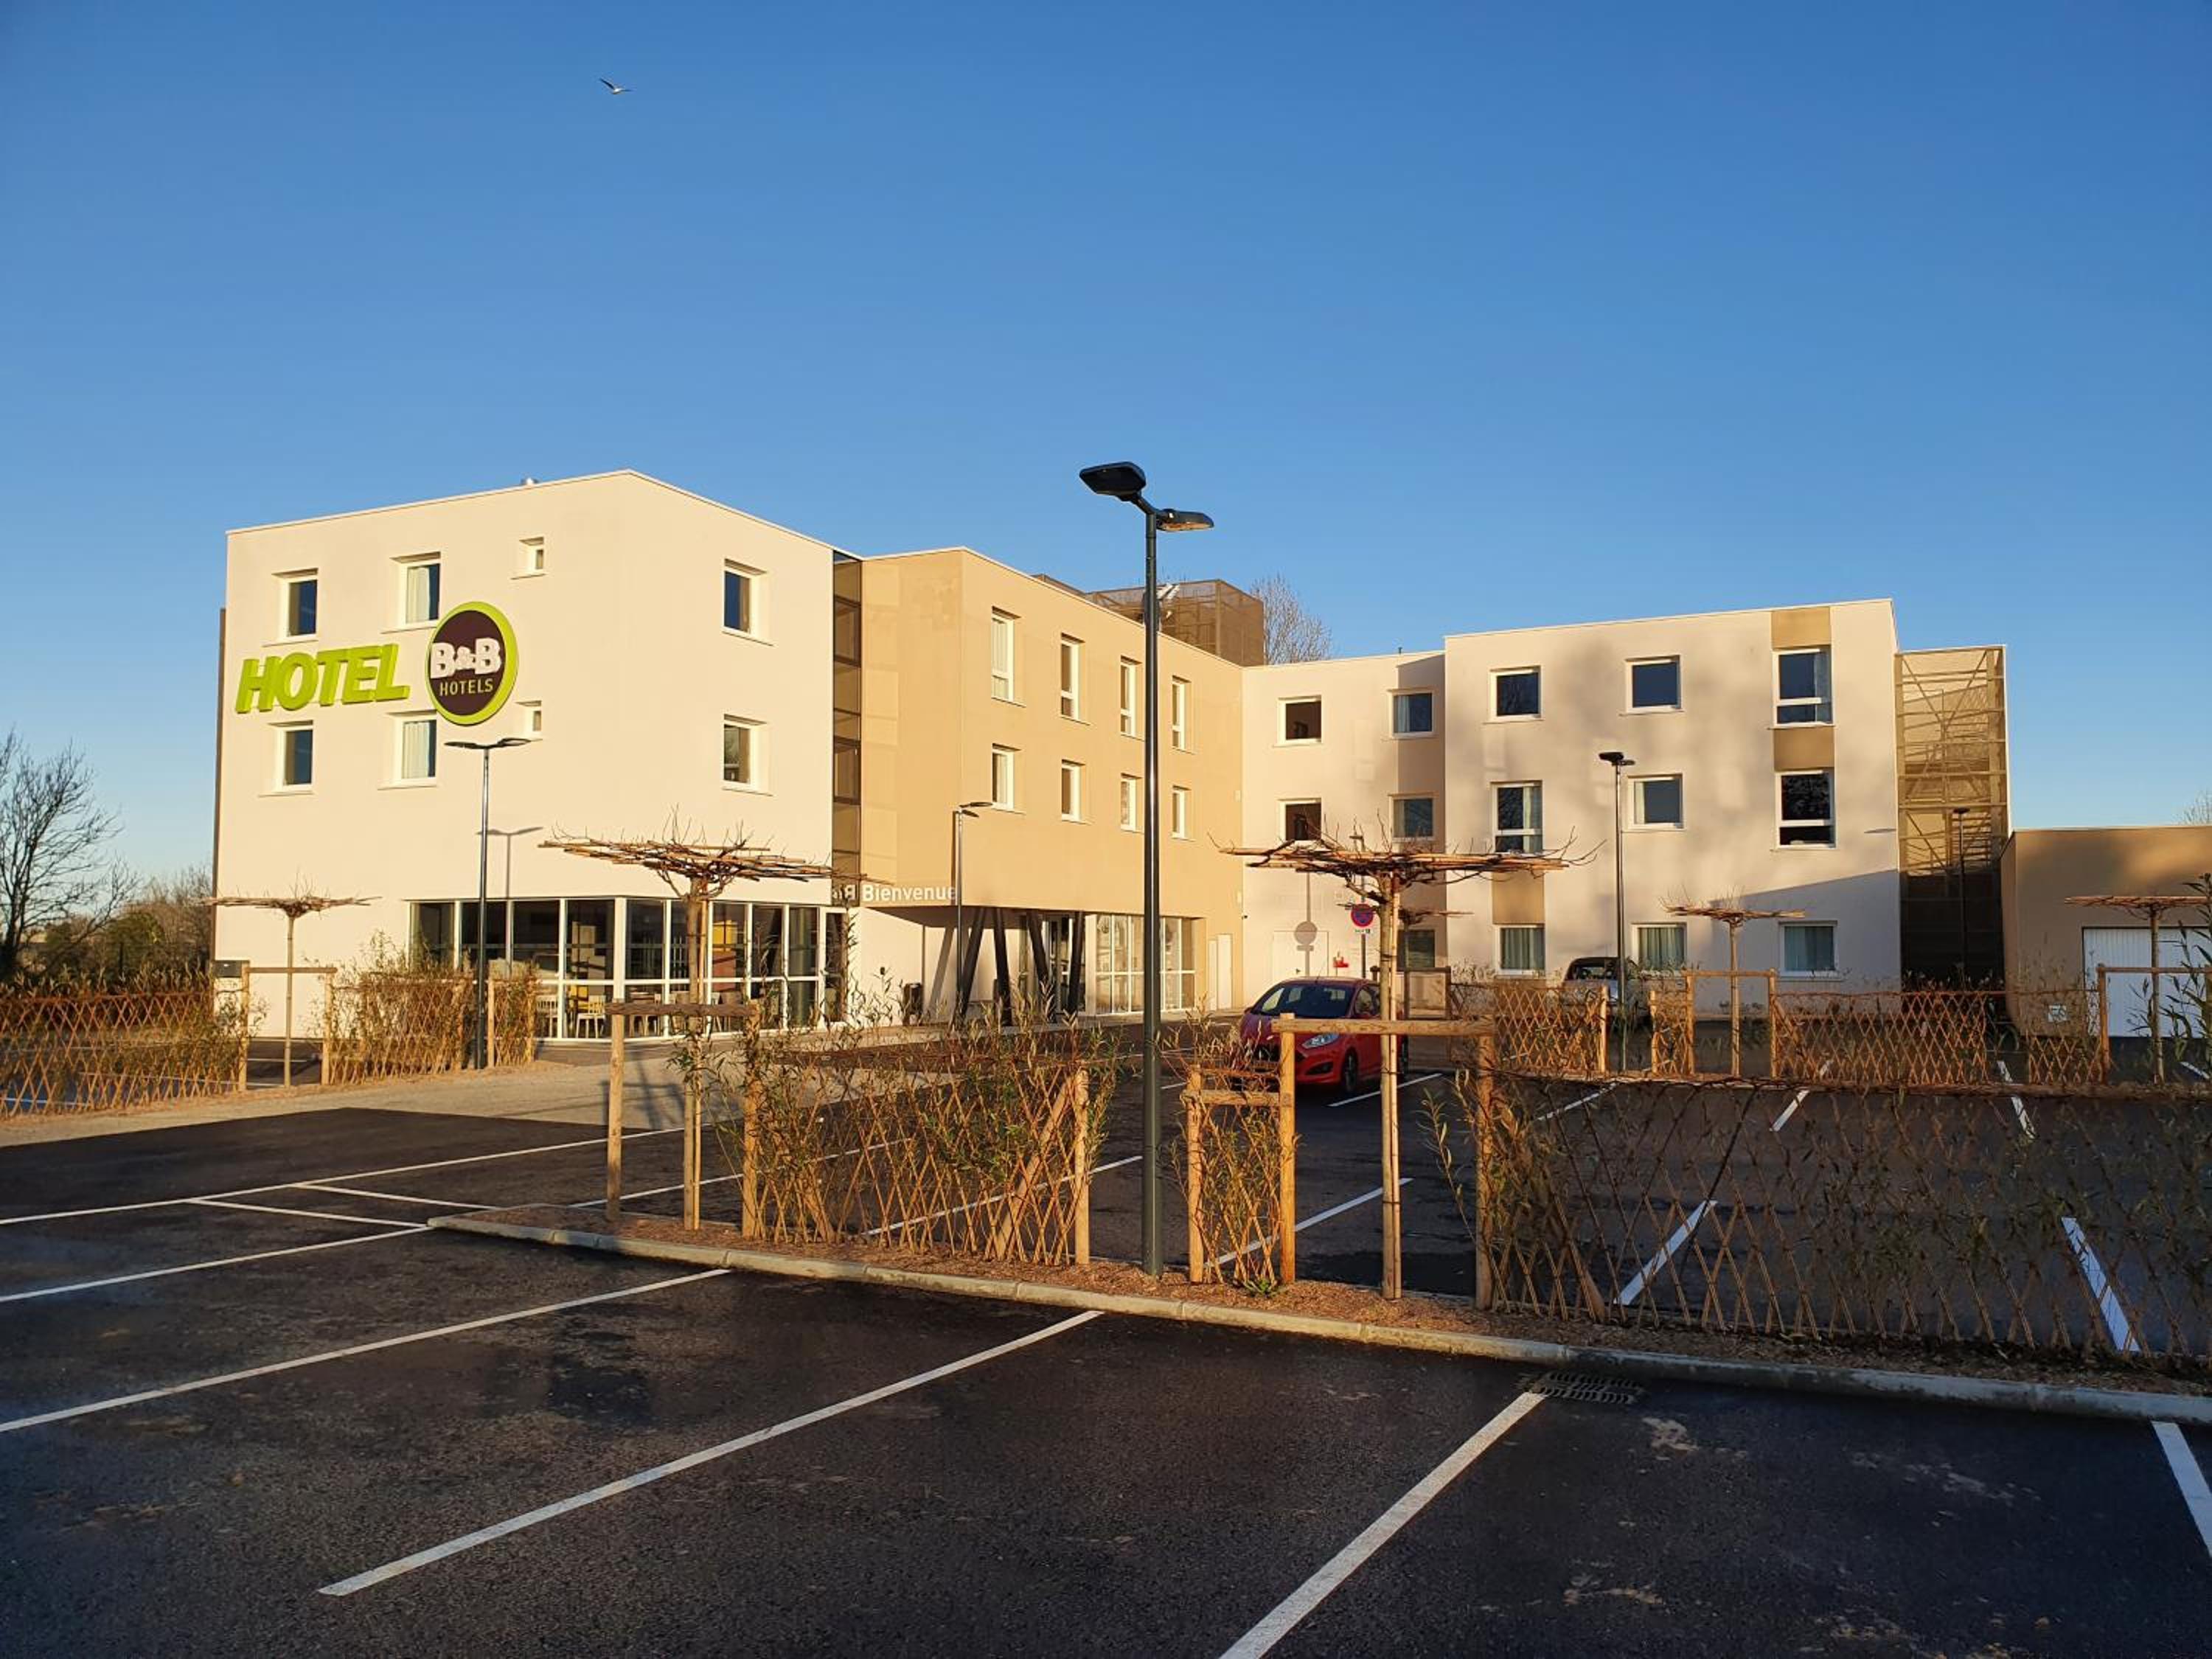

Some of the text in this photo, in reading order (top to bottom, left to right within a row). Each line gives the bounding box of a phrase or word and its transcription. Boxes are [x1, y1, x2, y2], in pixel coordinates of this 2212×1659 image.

[430, 637, 501, 678] B&B
[235, 644, 411, 714] HOTEL
[439, 678, 493, 696] HOTELS
